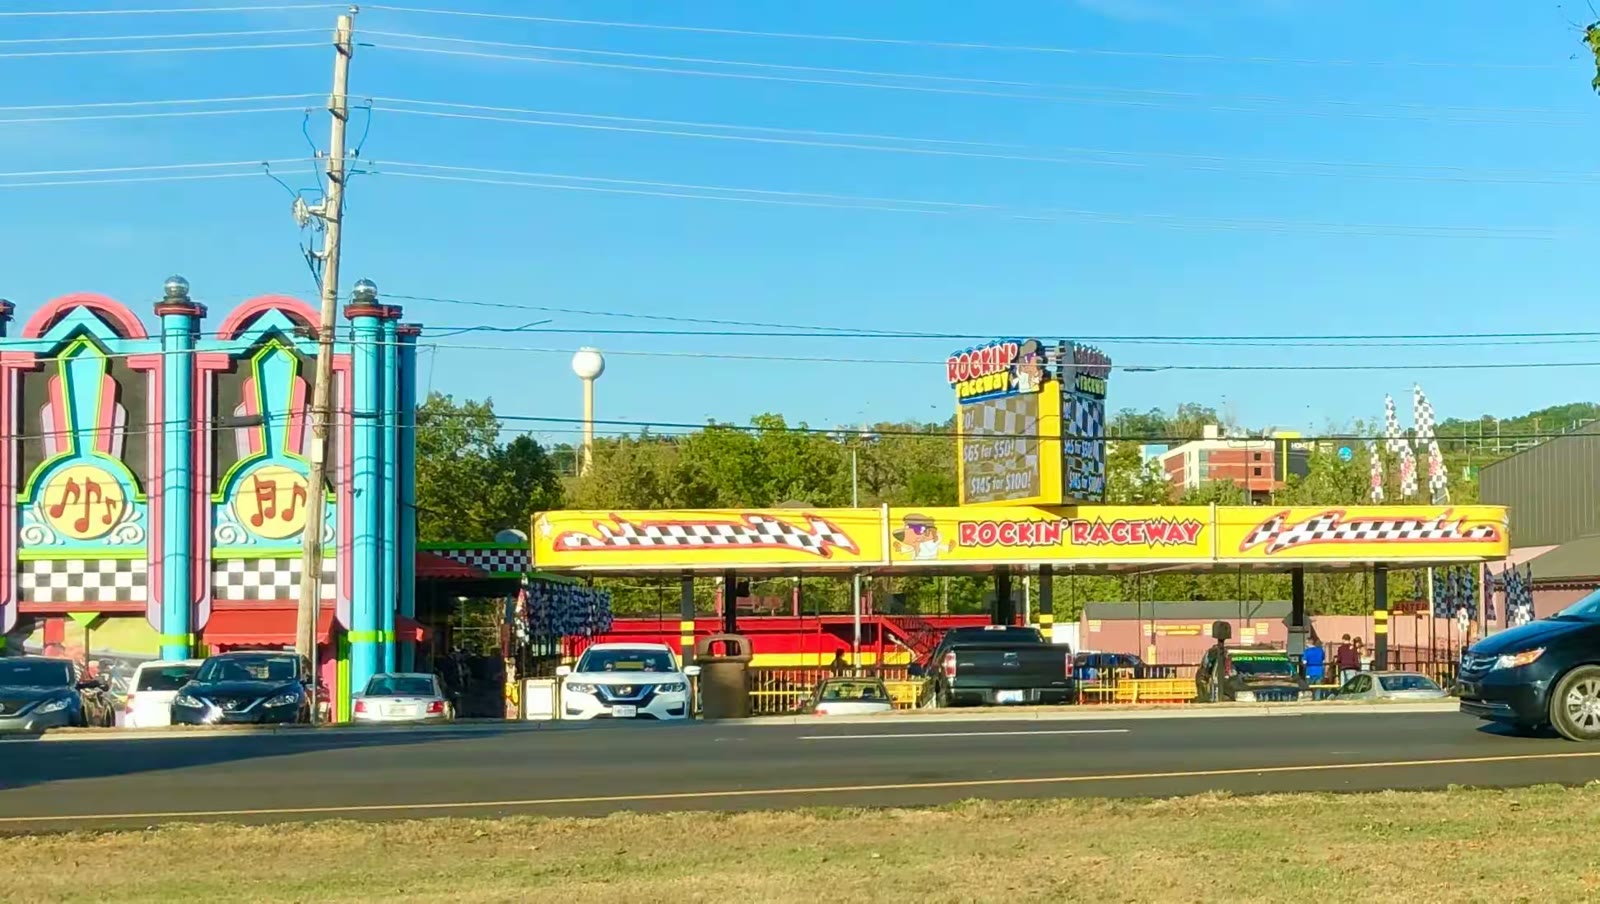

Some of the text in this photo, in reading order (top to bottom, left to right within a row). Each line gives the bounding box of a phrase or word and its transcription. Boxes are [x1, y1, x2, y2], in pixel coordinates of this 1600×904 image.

[946, 343, 1018, 384] ROCKIN'
[956, 371, 1009, 398] raceway
[981, 444, 992, 458] for
[994, 438, 1014, 460] $50!
[971, 470, 1031, 495] $145 for $100!
[958, 516, 1204, 548] ROCKIN' RACEWAY
